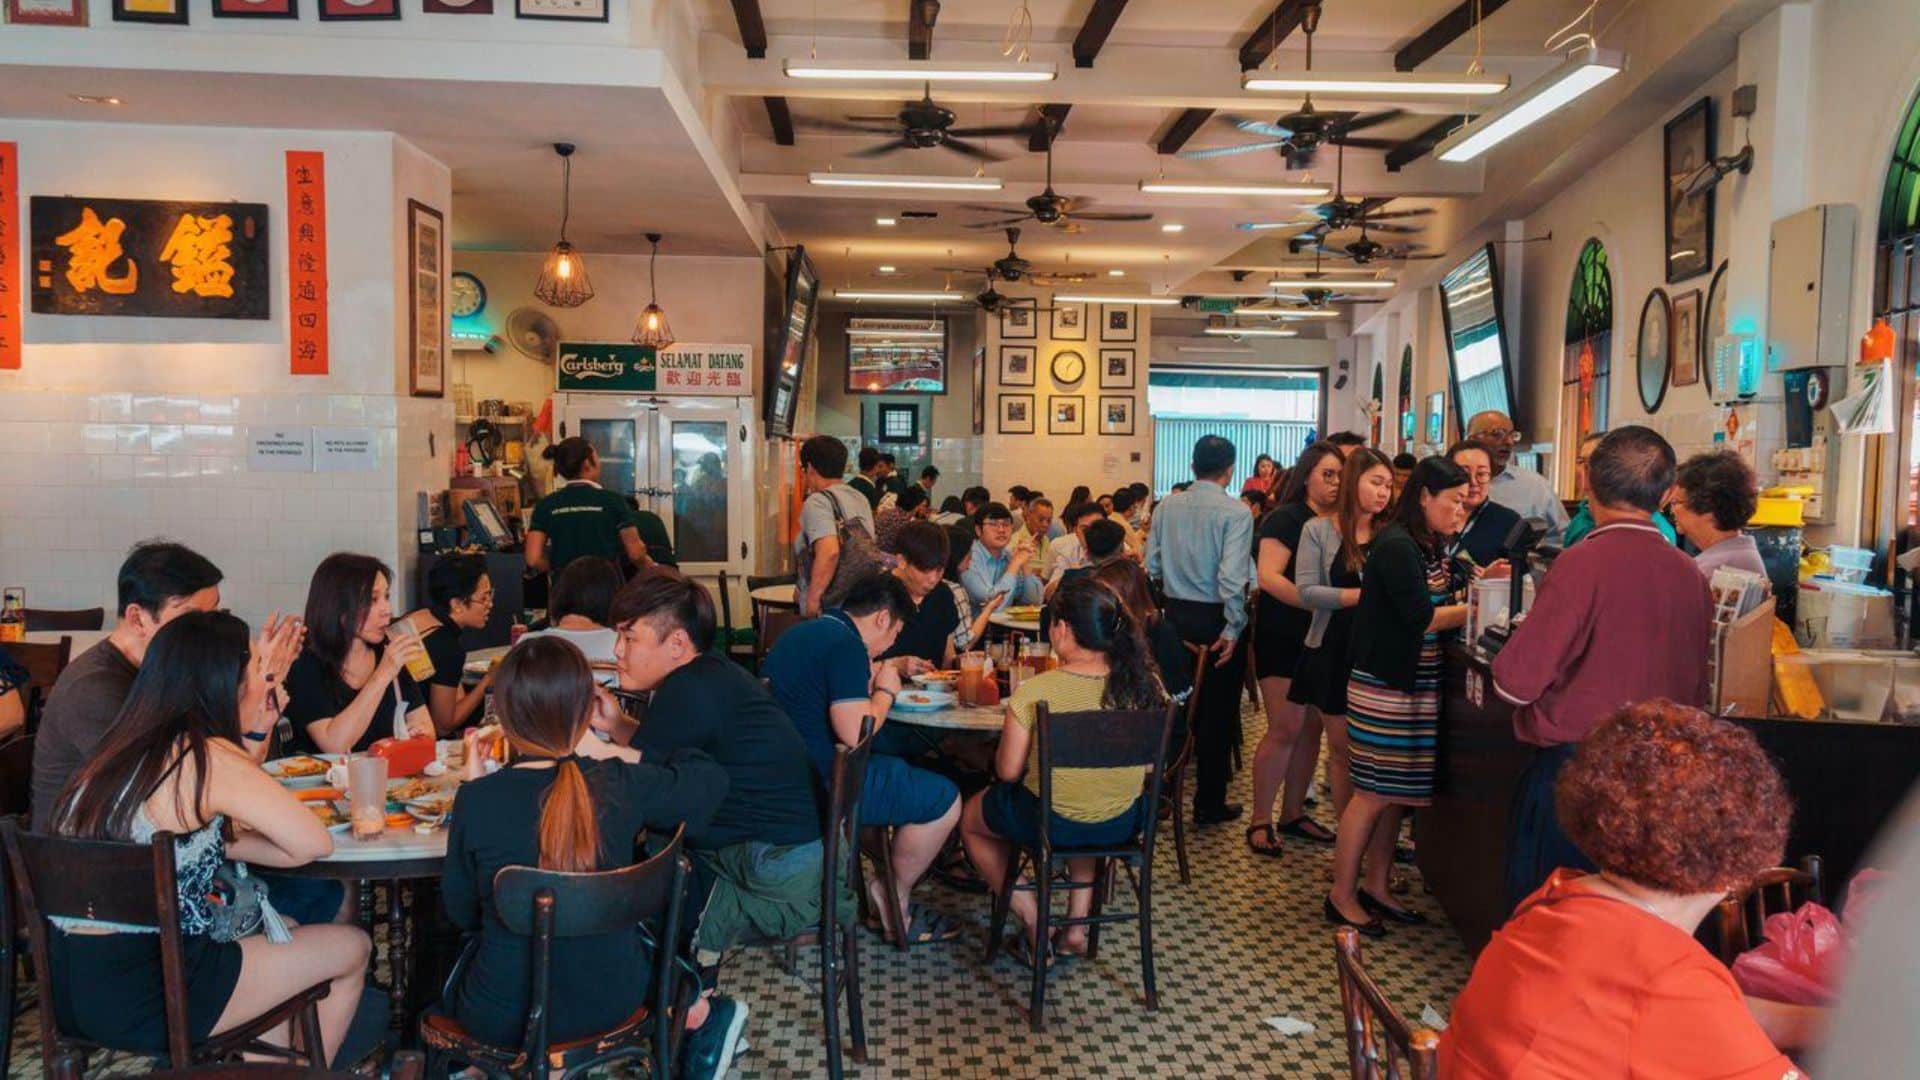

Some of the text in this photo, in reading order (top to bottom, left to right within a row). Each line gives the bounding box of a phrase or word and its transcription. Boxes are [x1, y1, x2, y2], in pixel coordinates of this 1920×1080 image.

[560, 353, 624, 377] Carlsberg
[660, 353, 702, 369] SELAMAT
[708, 353, 744, 369] DATANG
